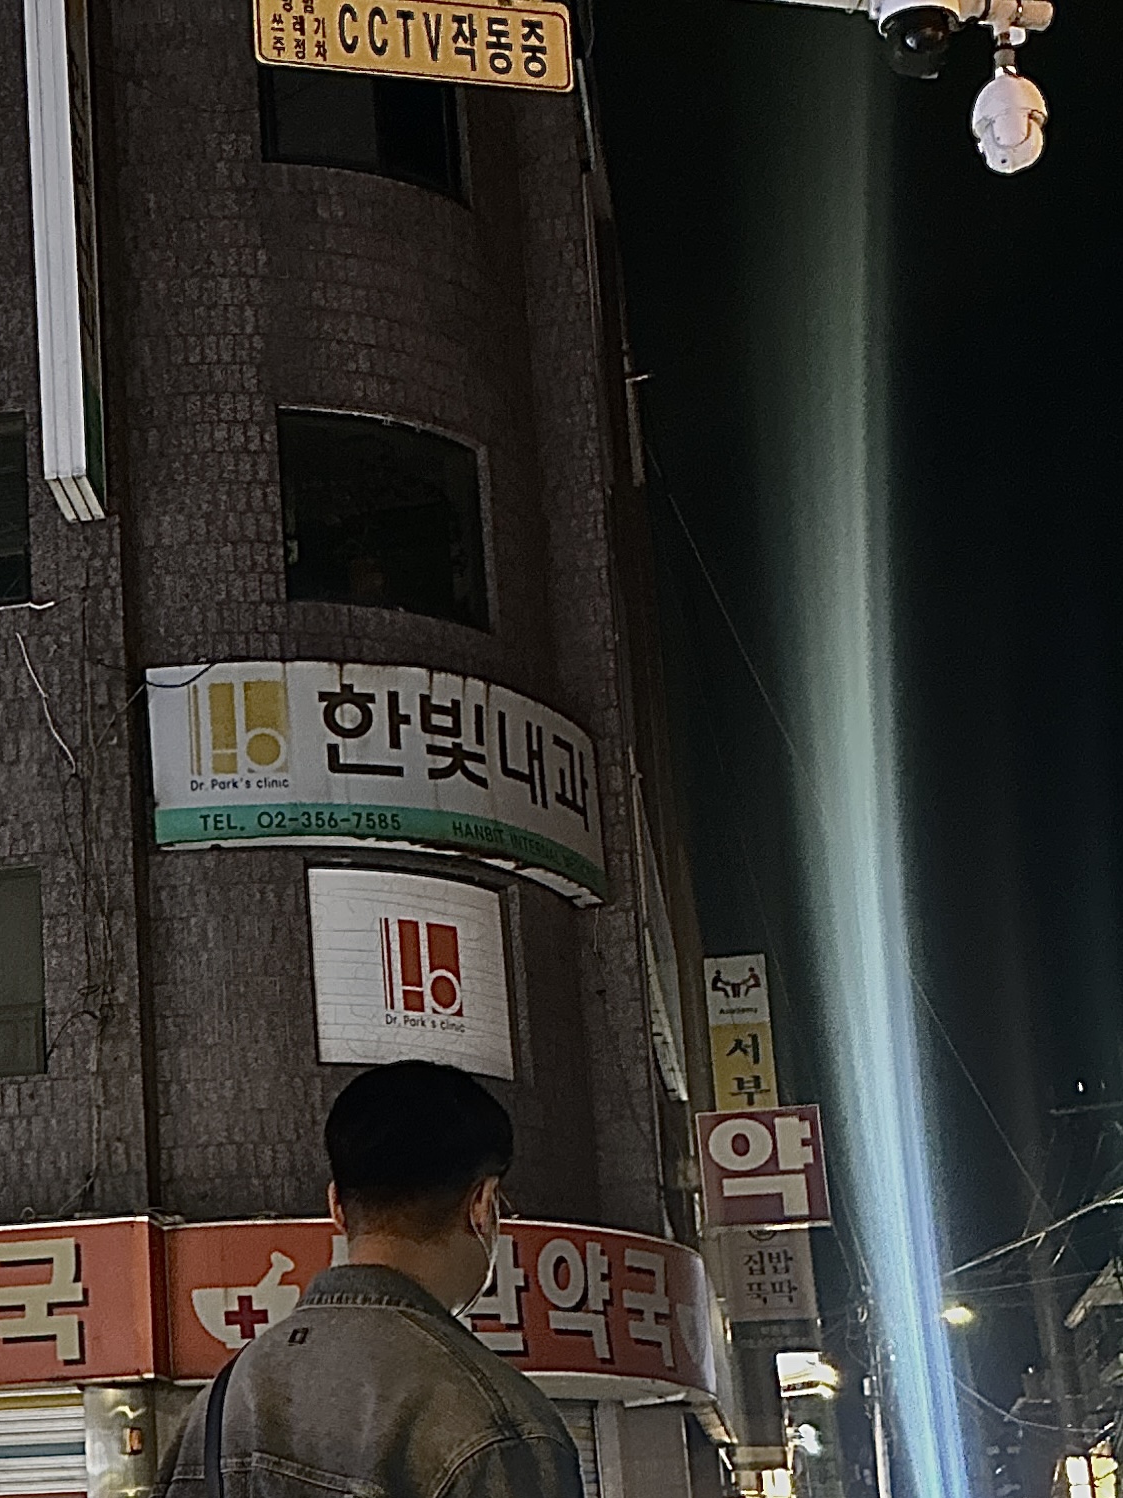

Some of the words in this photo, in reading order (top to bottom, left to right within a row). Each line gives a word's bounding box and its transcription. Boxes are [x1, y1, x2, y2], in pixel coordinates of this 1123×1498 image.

[270, 13, 327, 39] 쓰레기
[272, 36, 328, 61] 주정차
[317, 683, 590, 833] 한빛내과
[210, 777, 252, 791] Park's
[256, 776, 289, 789] clinic
[199, 814, 246, 832] TEL.
[256, 810, 402, 832] 02-356-7585
[452, 820, 504, 844] HANBIT
[726, 1032, 771, 1106] 서부
[708, 1114, 815, 1217] 약
[743, 1249, 794, 1276] 집밥
